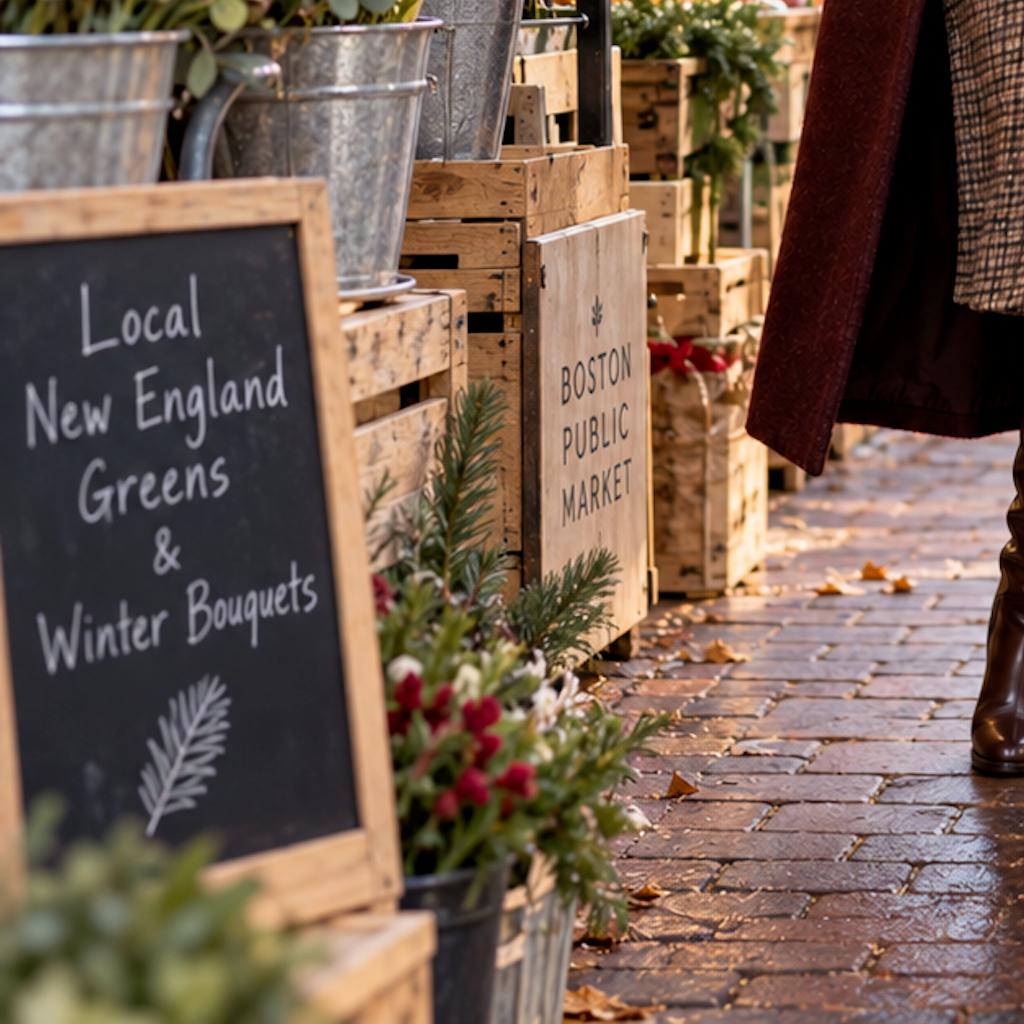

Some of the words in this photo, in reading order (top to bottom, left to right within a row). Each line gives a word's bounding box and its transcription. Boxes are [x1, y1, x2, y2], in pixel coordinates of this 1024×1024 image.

[80, 274, 201, 356] Local
[26, 377, 112, 448] New
[135, 345, 288, 450] England
[561, 342, 632, 406] BOSTON
[562, 402, 630, 465] PUBLIC
[78, 456, 230, 524] Greens
[562, 458, 633, 527] MARKET
[153, 526, 181, 575] &
[37, 602, 168, 674] Winter
[186, 561, 319, 647] Bouquets
